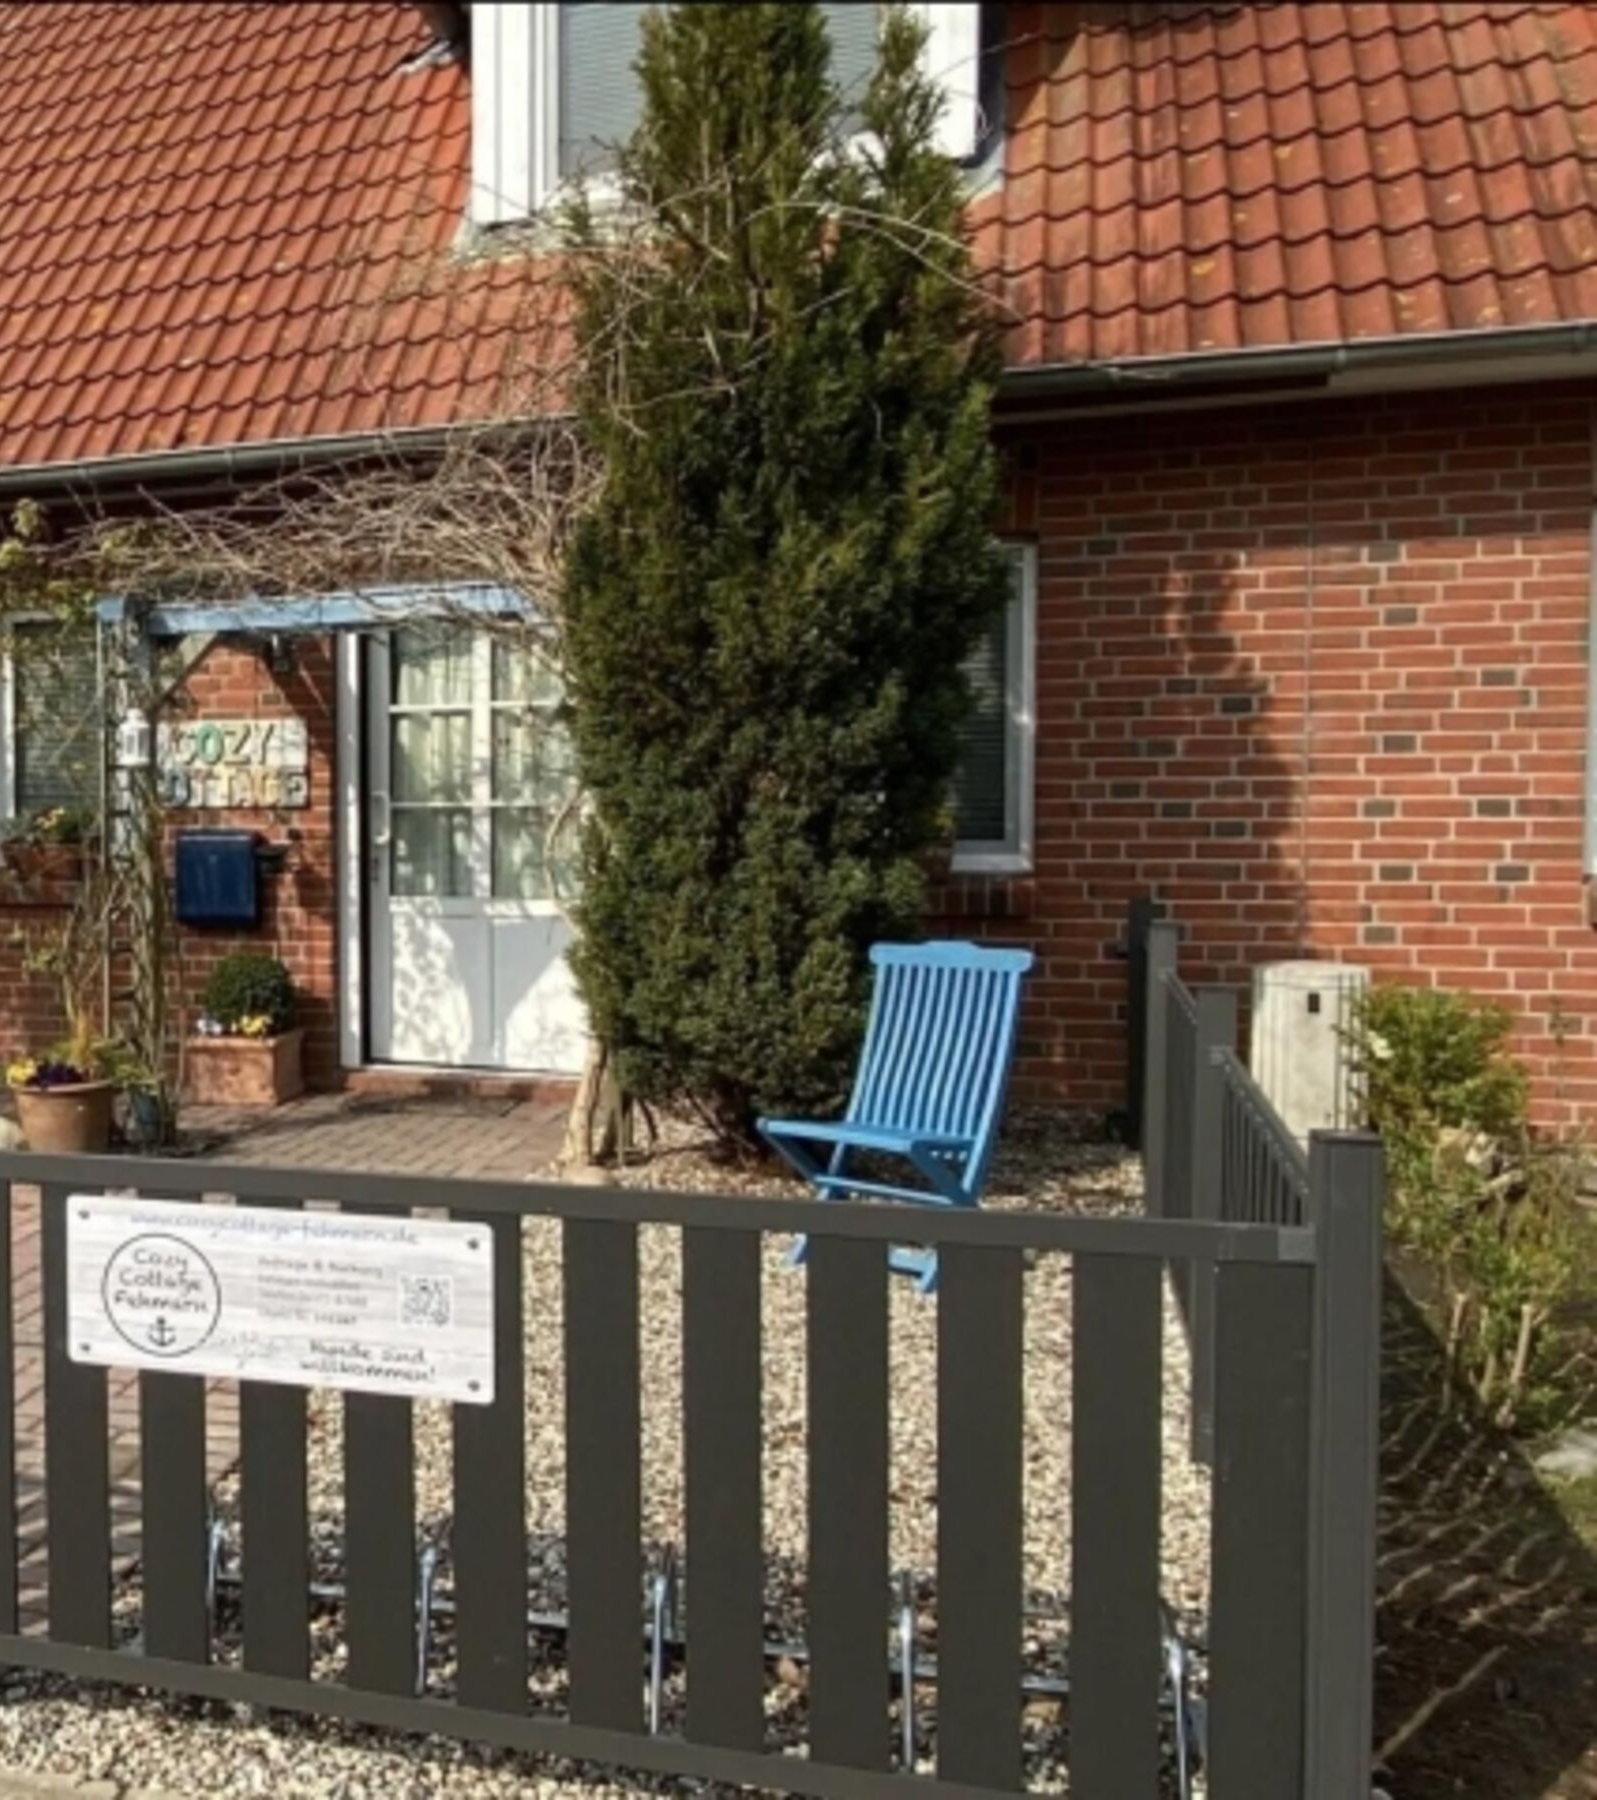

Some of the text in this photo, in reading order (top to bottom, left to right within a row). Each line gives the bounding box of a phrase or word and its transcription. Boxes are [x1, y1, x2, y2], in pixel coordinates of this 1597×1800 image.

[171, 723, 275, 765] COZY
[133, 1247, 189, 1274] Cozy
[119, 1268, 203, 1296] Cottage
[114, 1289, 208, 1313] Fehmarn
[309, 1340, 426, 1364] Hunde sind
